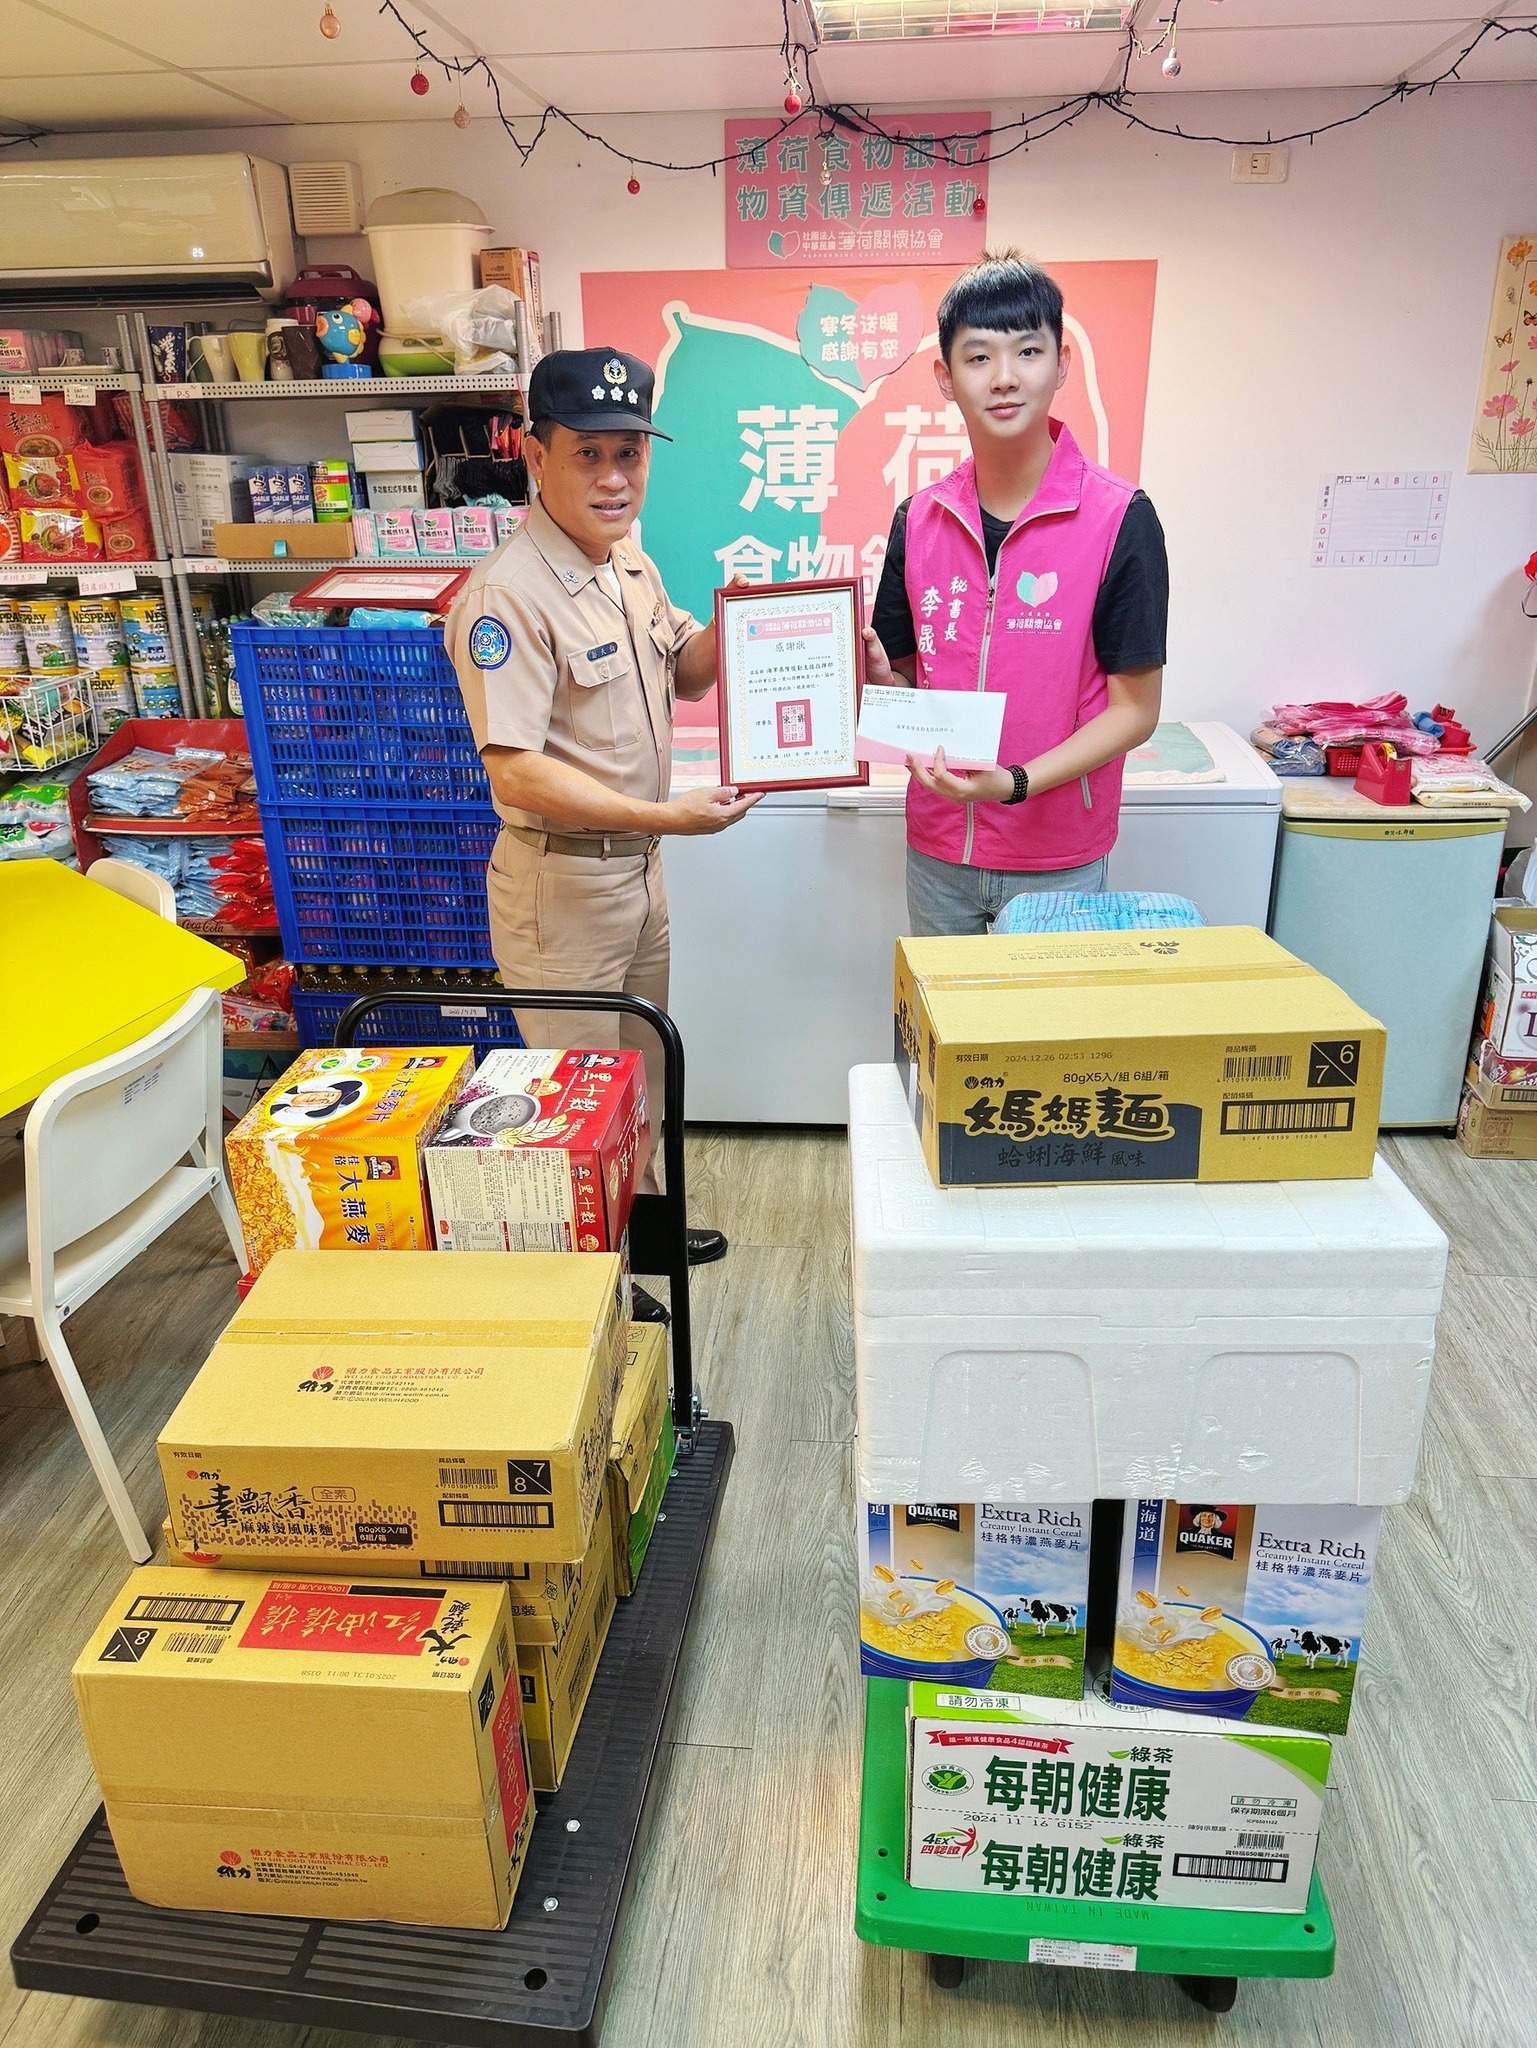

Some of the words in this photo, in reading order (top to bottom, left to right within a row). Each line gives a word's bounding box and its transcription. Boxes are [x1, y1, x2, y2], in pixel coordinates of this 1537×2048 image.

[735, 131, 981, 175] 薄荷食物銀行
[736, 180, 979, 222] 物資傳遞活動
[802, 240, 836, 250] 中華民國
[837, 229, 944, 250] 薄荷關懷協會
[820, 311, 898, 337] 寒冬送暖
[821, 339, 898, 362] 感謝有您
[737, 404, 975, 512] 薄荷
[1374, 477, 1380, 485] A
[1393, 477, 1400, 485] B
[1412, 476, 1419, 484] C
[1432, 476, 1439, 484] D
[1437, 494, 1443, 502] E
[1434, 513, 1440, 521] F
[1319, 527, 1326, 535] O
[1413, 533, 1420, 542] H
[1431, 533, 1438, 541] G
[943, 575, 968, 642] 秘書長
[72, 610, 117, 625] NESPRAY
[1006, 618, 1063, 631] 薄荷關懷協會
[955, 1053, 989, 1063] 有效日期
[1004, 1053, 1056, 1063] 2024.12.26
[1058, 1052, 1086, 1061] 02:53
[1090, 1051, 1113, 1060] 1296
[1339, 1044, 1355, 1065] 6
[1063, 1071, 1130, 1085] 80gX5入/組
[1133, 1070, 1170, 1081] 6組/箱
[1315, 1064, 1330, 1084] 7
[564, 1069, 613, 1113] 黑十穀
[366, 1078, 415, 1124] 大燕麥片
[964, 1085, 1171, 1138] 媽媽麵
[998, 1141, 1107, 1168] 蛤蜊海鮮
[1110, 1150, 1147, 1168] 風味
[532, 1462, 546, 1478] 7
[514, 1477, 527, 1493] 8
[319, 1488, 348, 1500] 全素
[193, 1482, 312, 1528] 素飄香
[907, 1505, 958, 1521] QUAKER
[981, 1503, 1030, 1523] Extra
[1037, 1508, 1082, 1528] Rich
[240, 1521, 334, 1537] 麻辣燙風味麵
[980, 1520, 1016, 1533] Creamy
[1018, 1523, 1050, 1535] Instant
[1052, 1526, 1082, 1538] Cereal
[980, 1532, 1081, 1550] 桂格特濃燕麥片
[1179, 1531, 1233, 1549] QUAKER
[1257, 1532, 1311, 1554] Extra
[1320, 1539, 1367, 1560] Rich
[1256, 1549, 1293, 1564] Creamy
[1297, 1552, 1331, 1566] Instant
[1333, 1557, 1365, 1570] Cereal
[1255, 1560, 1363, 1583] 桂格特濃燕麥片
[135, 1630, 150, 1646] 8
[105, 1644, 121, 1660] 7
[948, 1695, 1010, 1708] 請勿冷凍
[1130, 1745, 1174, 1764] 綠茶
[983, 1755, 1172, 1822] 每朝健康
[1230, 1806, 1297, 1818] 保存期限6個月
[963, 1813, 998, 1824] 2024
[1007, 1817, 1022, 1825] 11
[1032, 1819, 1049, 1828] 16
[1057, 1821, 1093, 1830] G152
[920, 1844, 961, 1855] 四認證
[1122, 1833, 1166, 1850] 綠茶
[980, 1840, 1163, 1902] 每朝健康
